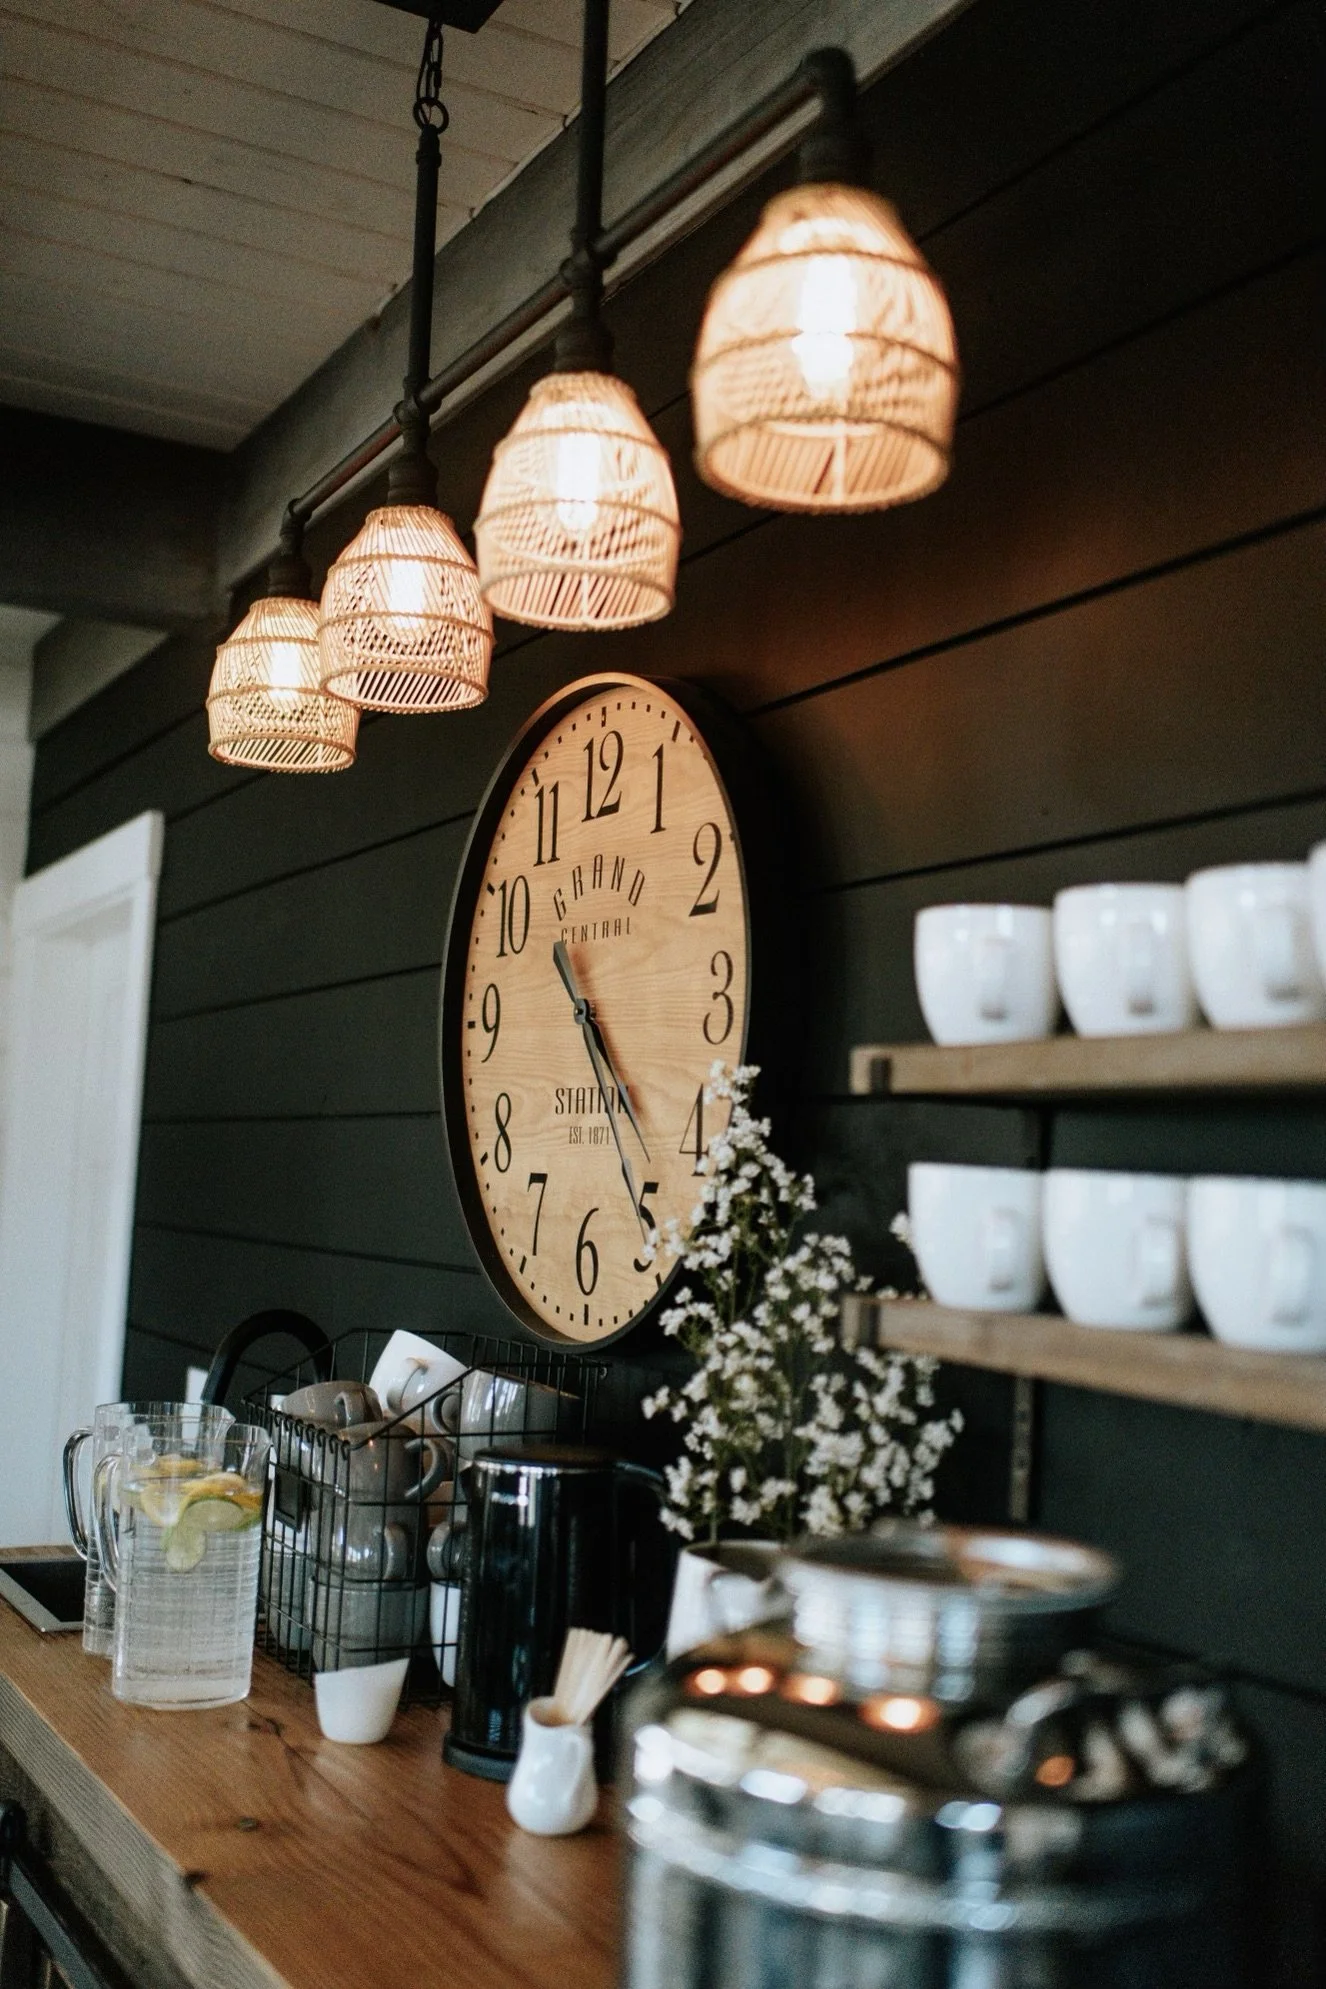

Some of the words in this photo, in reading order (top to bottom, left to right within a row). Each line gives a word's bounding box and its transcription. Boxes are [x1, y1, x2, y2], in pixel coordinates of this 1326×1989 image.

[581, 730, 624, 822] 12
[650, 743, 666, 834] 1
[533, 780, 561, 867] 11
[552, 853, 645, 921] GRAND
[689, 822, 722, 917] 2
[496, 875, 530, 958] 10
[561, 916, 632, 945] CENTRAL
[481, 983, 501, 1063] 9
[703, 951, 734, 1046] 3
[494, 1092, 512, 1173] 8
[568, 1126, 584, 1145] EST.
[679, 1082, 709, 1177] 4
[526, 1172, 548, 1256] 7
[575, 1207, 599, 1296] 6
[633, 1181, 660, 1273] 5
